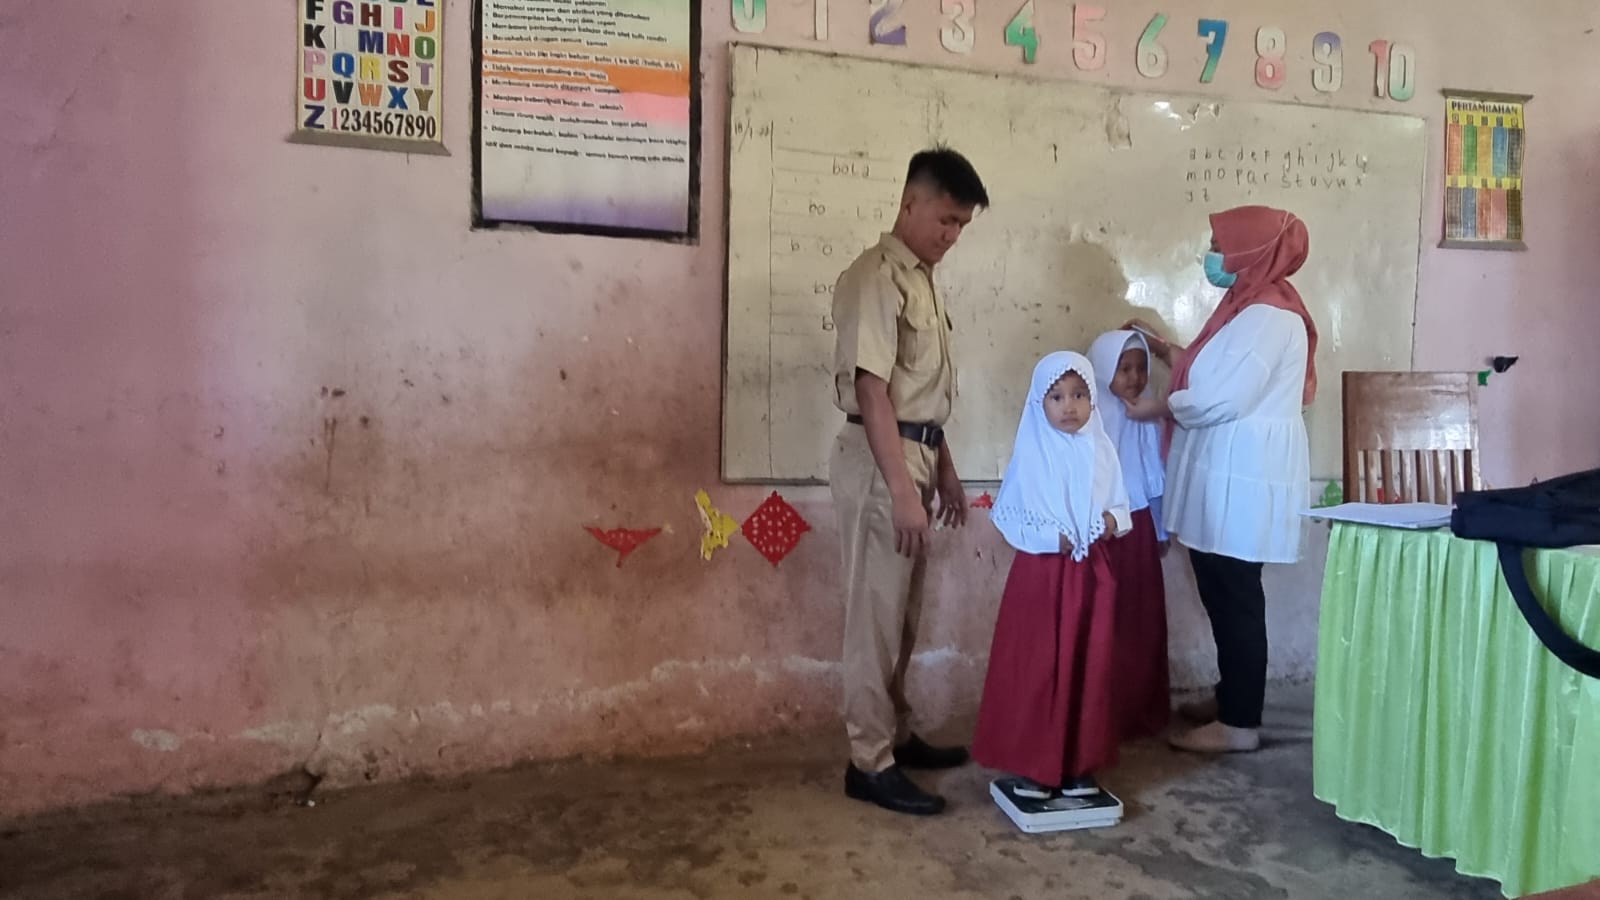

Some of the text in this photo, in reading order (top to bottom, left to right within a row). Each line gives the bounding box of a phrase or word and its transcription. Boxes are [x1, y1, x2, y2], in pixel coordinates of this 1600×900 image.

[333, 1, 353, 25] G
[360, 3, 381, 27] H
[415, 10, 435, 32] J
[304, 23, 325, 48] K
[358, 29, 384, 54] M
[387, 32, 410, 57] N
[415, 36, 435, 60] O
[940, 0, 975, 53] 3
[1005, 0, 1037, 63] 4
[1073, 4, 1106, 71] 5
[1136, 13, 1168, 78] 6
[1198, 19, 1228, 83] 7
[1255, 25, 1285, 89] 8
[1312, 32, 1343, 92] 9
[1368, 40, 1415, 101] 10
[304, 50, 434, 85] P Q R S T
[304, 77, 433, 111] U V W X Y
[1451, 100, 1519, 115] PERTAMBAHAN
[304, 104, 436, 139] Z 1234567890
